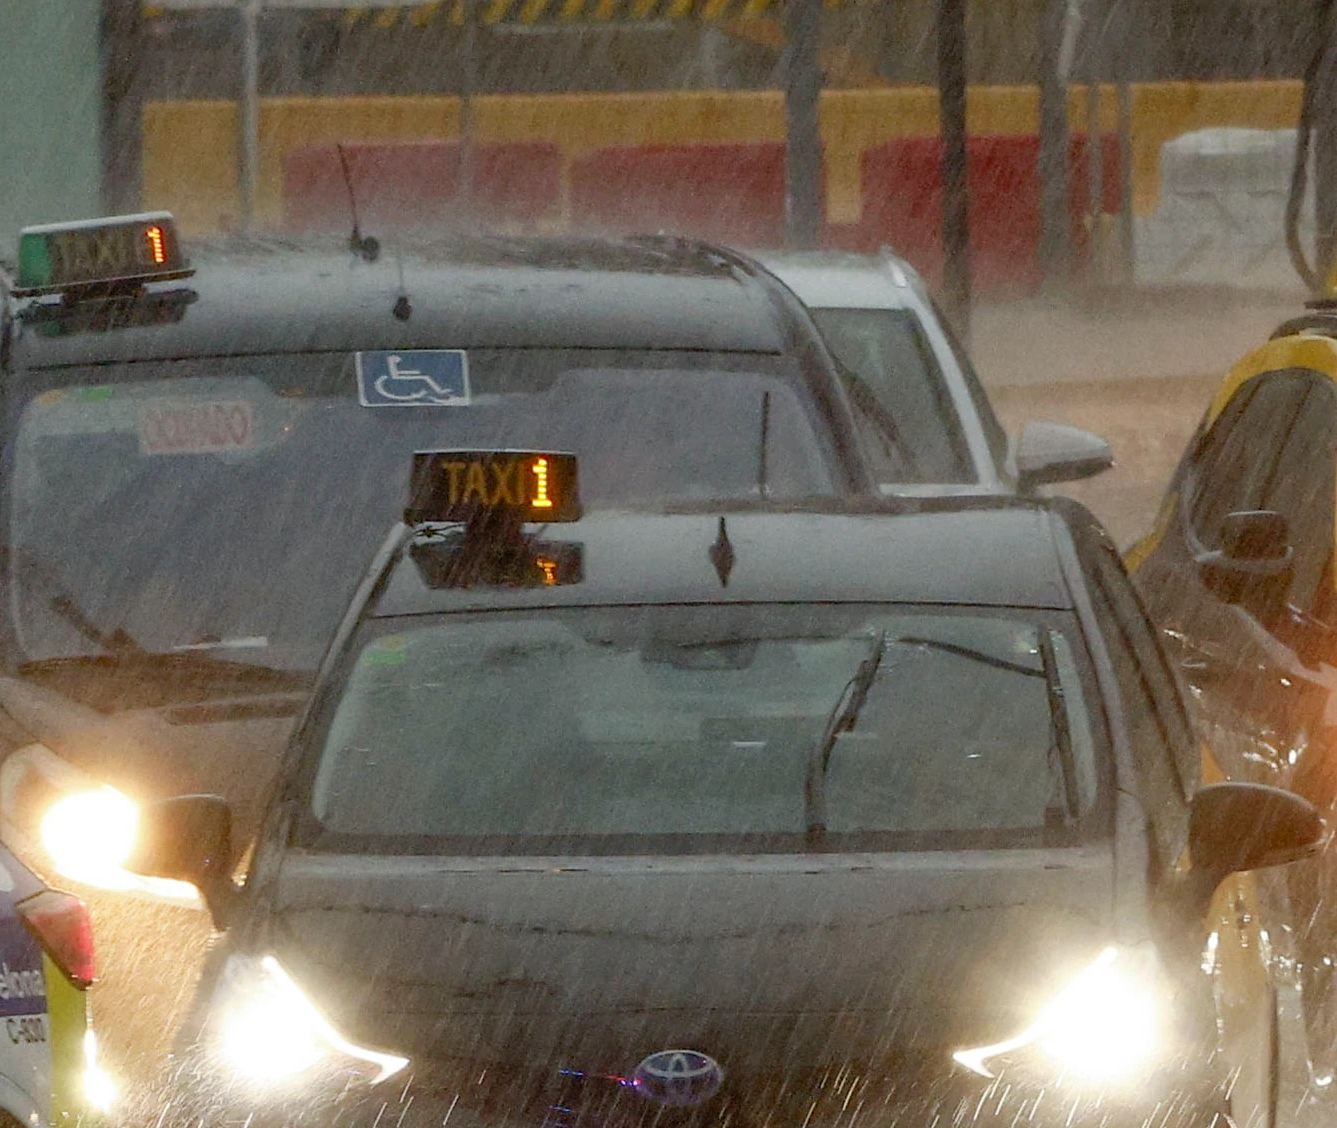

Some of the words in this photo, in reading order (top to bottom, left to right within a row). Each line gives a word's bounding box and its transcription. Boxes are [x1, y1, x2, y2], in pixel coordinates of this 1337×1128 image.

[54, 231, 127, 273] TAXI
[146, 226, 166, 263] 1
[441, 461, 525, 505] TAXI
[532, 458, 552, 508] 1
